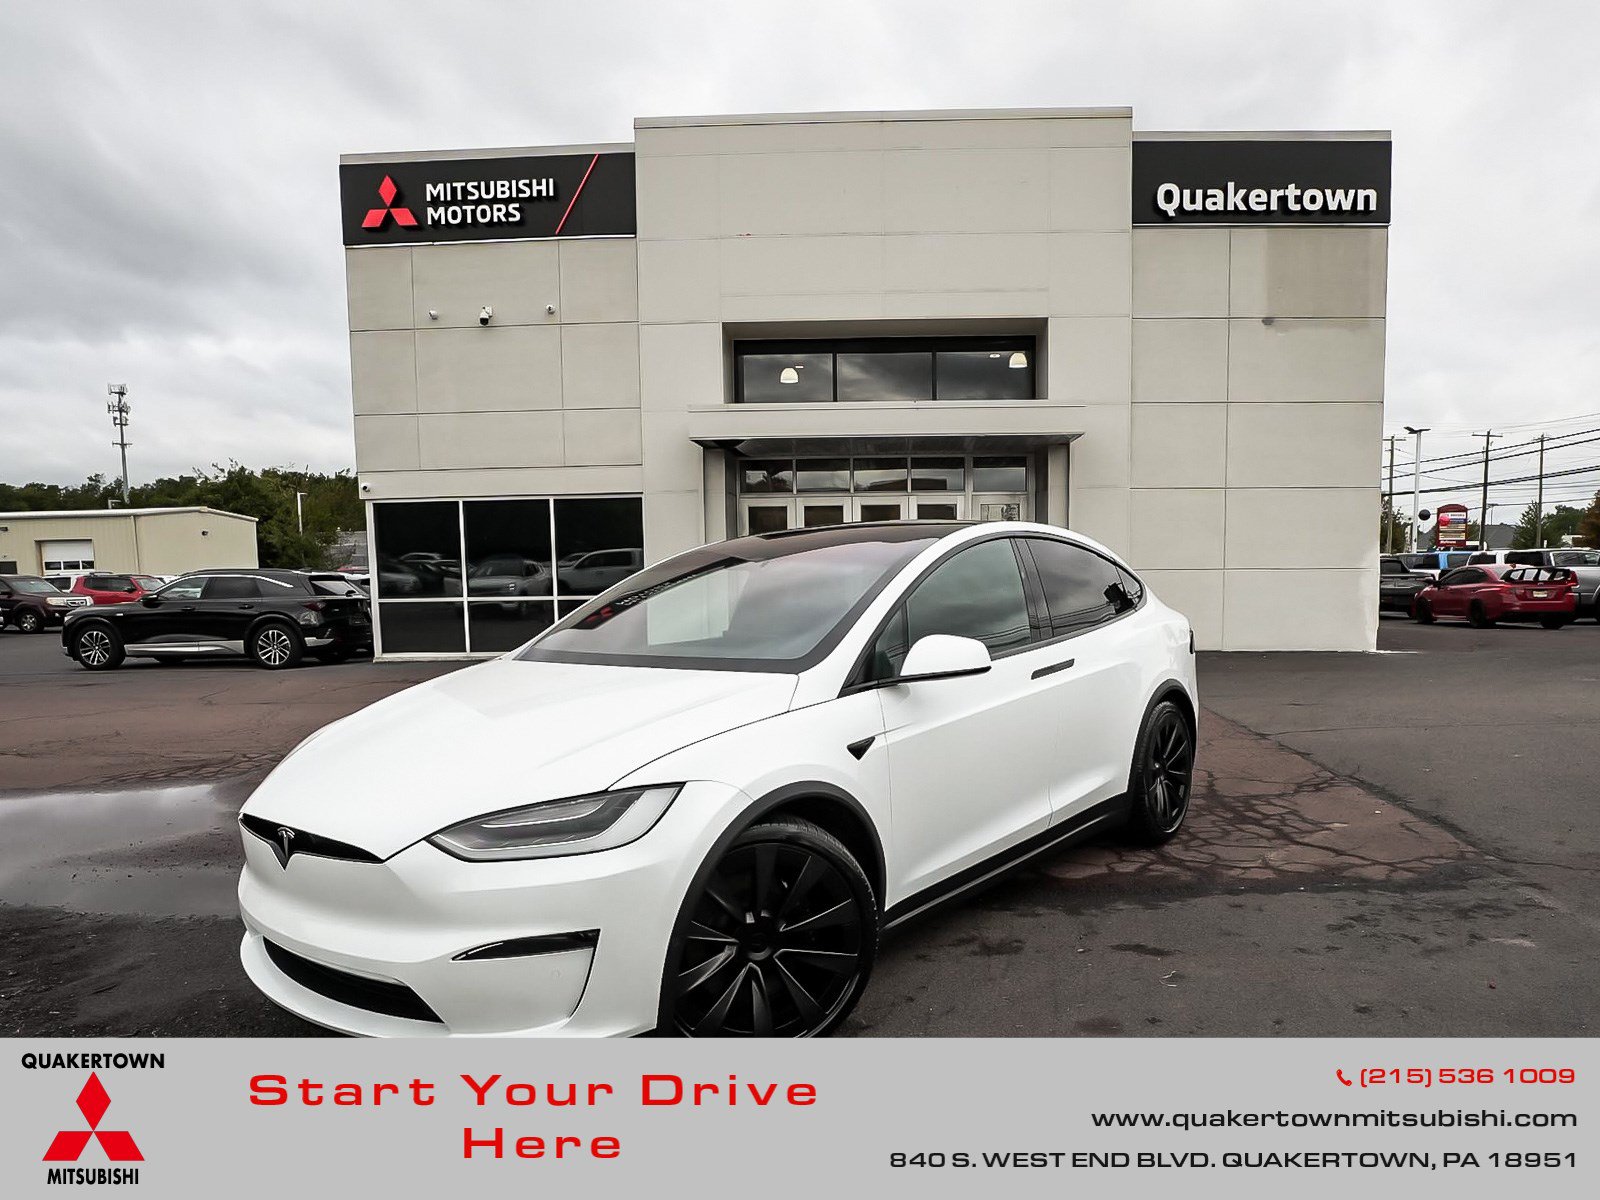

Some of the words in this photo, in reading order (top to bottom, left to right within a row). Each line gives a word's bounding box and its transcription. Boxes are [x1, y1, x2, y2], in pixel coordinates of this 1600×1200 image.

[425, 178, 554, 202] MITSUBISHI
[1156, 181, 1377, 217] Quakertown
[426, 203, 521, 226] MOTORS
